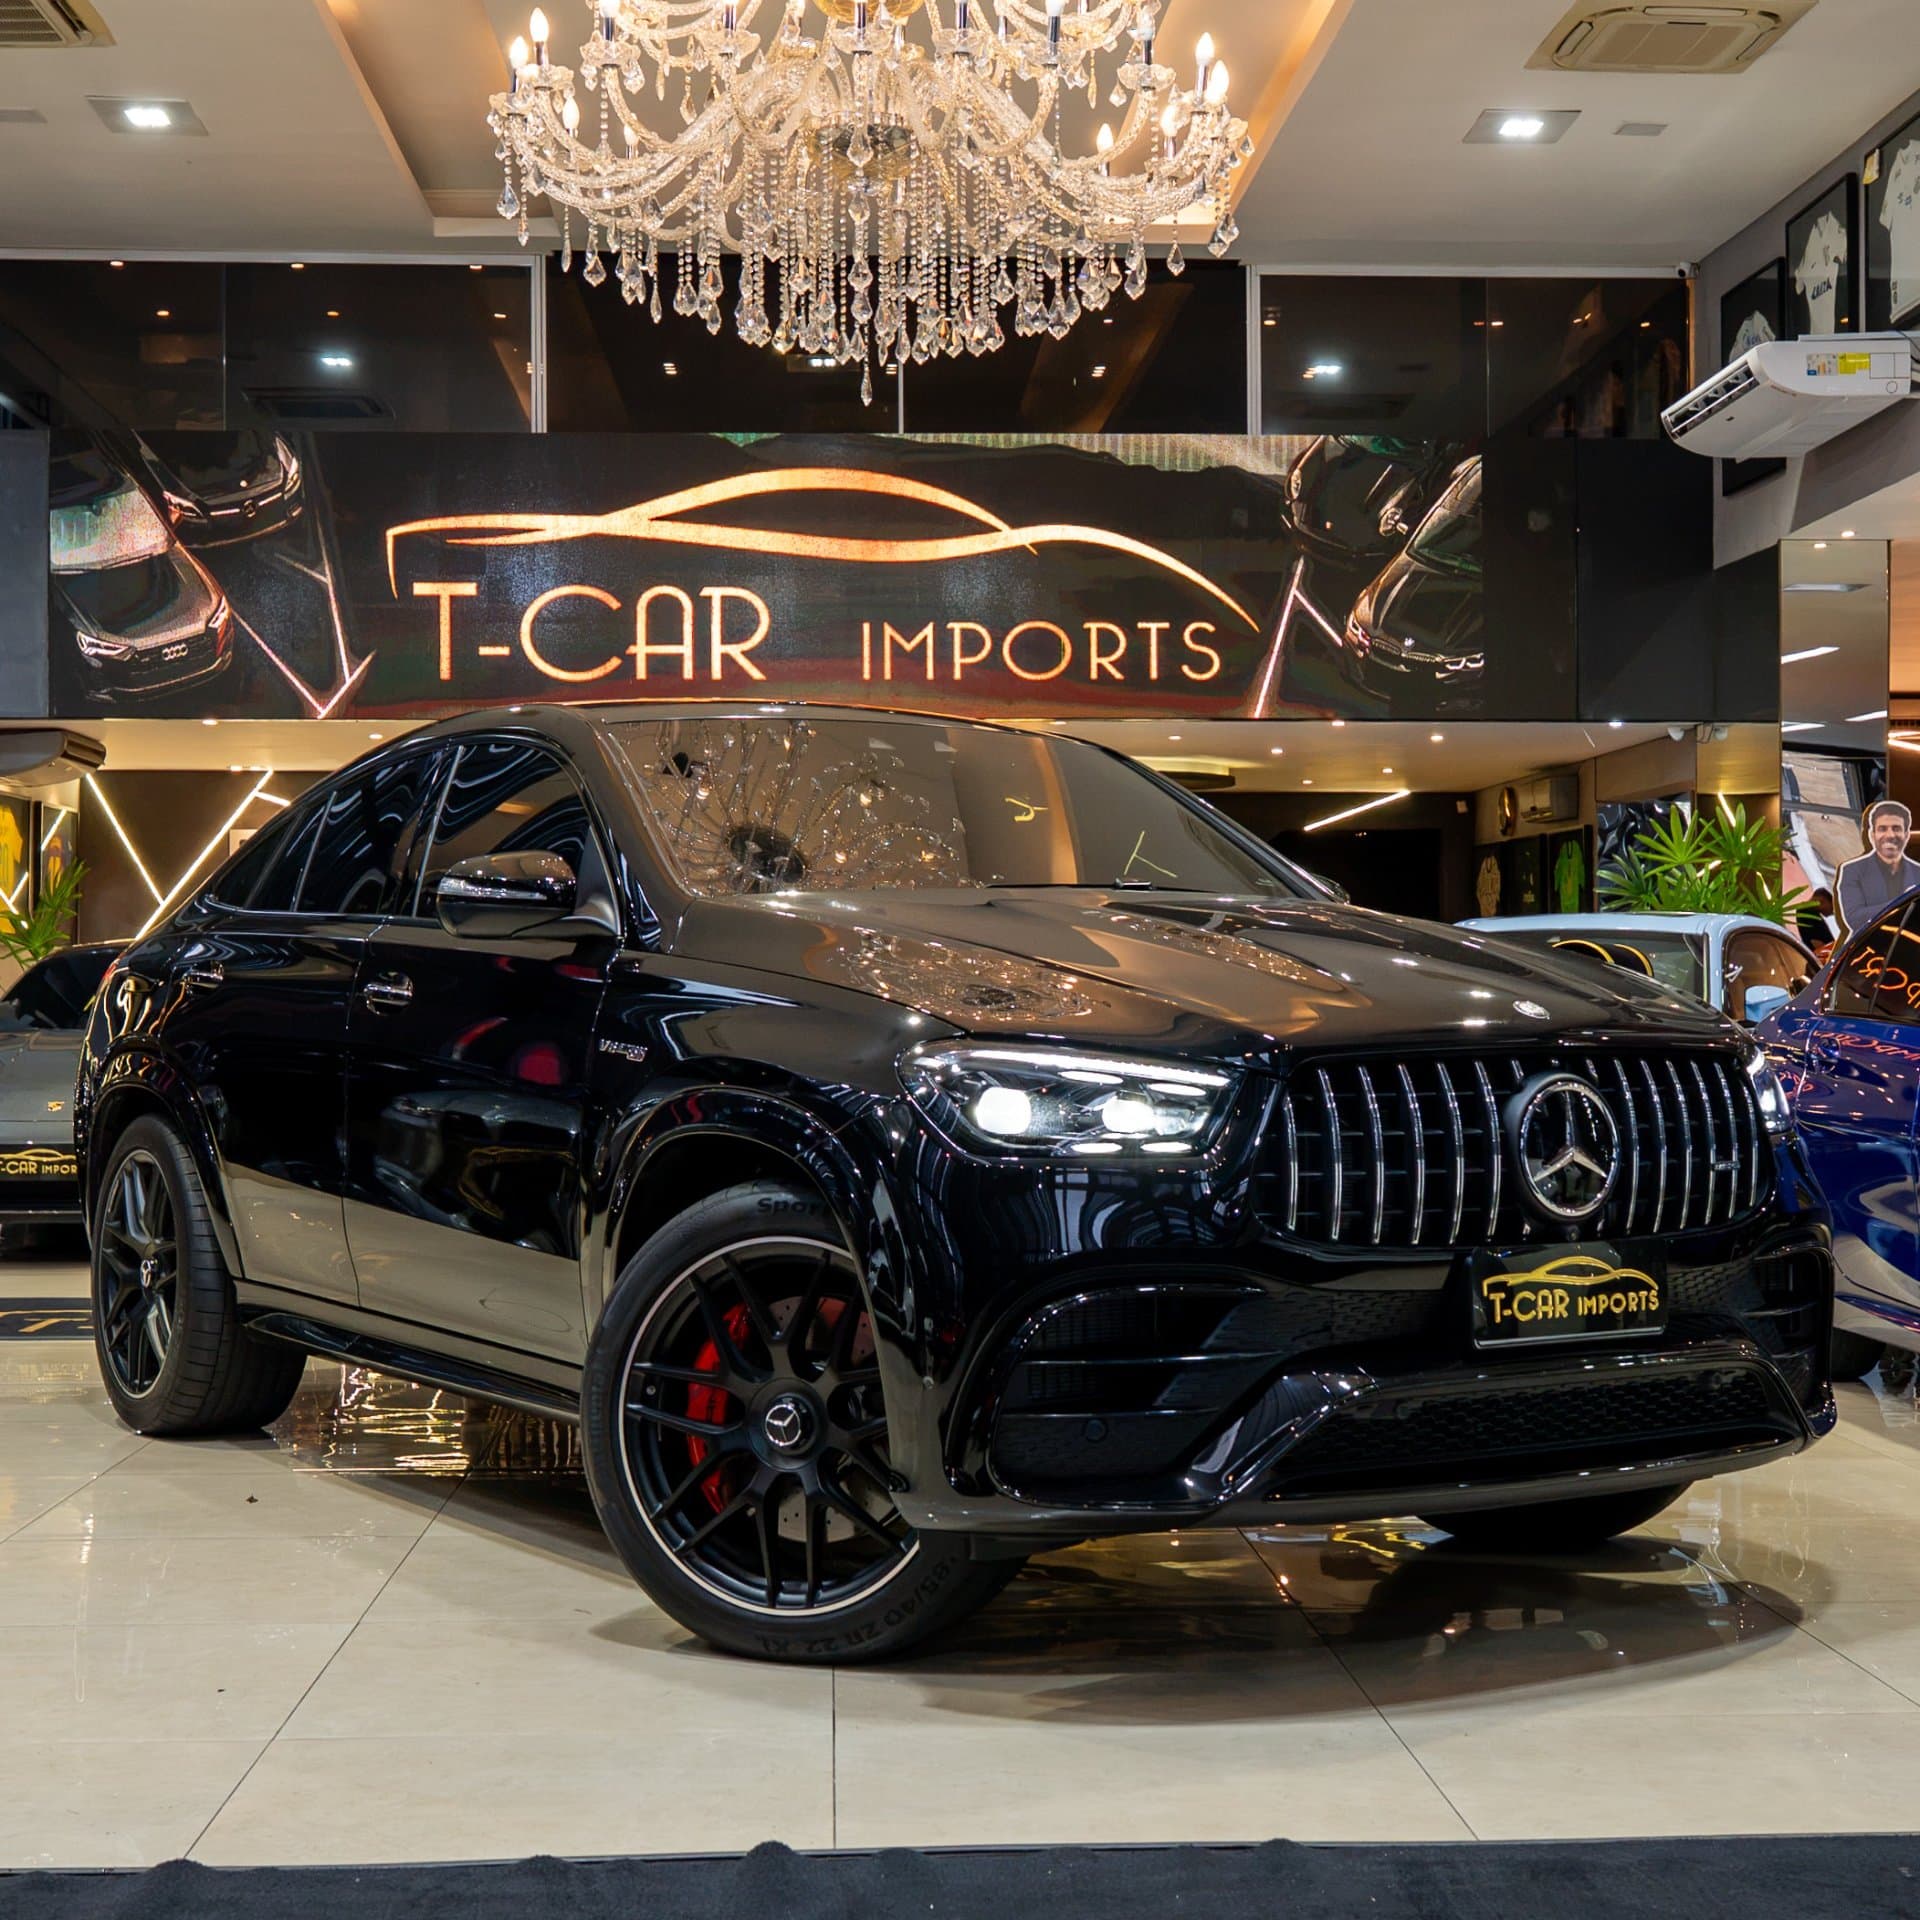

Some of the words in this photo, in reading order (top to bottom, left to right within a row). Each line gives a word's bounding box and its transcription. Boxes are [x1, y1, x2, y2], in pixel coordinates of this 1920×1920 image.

[413, 582, 770, 683] T-CAR
[861, 620, 1220, 682] IMPORTS
[1489, 1288, 1570, 1324] T-CAR
[1577, 1290, 1660, 1316] IMPORTS
